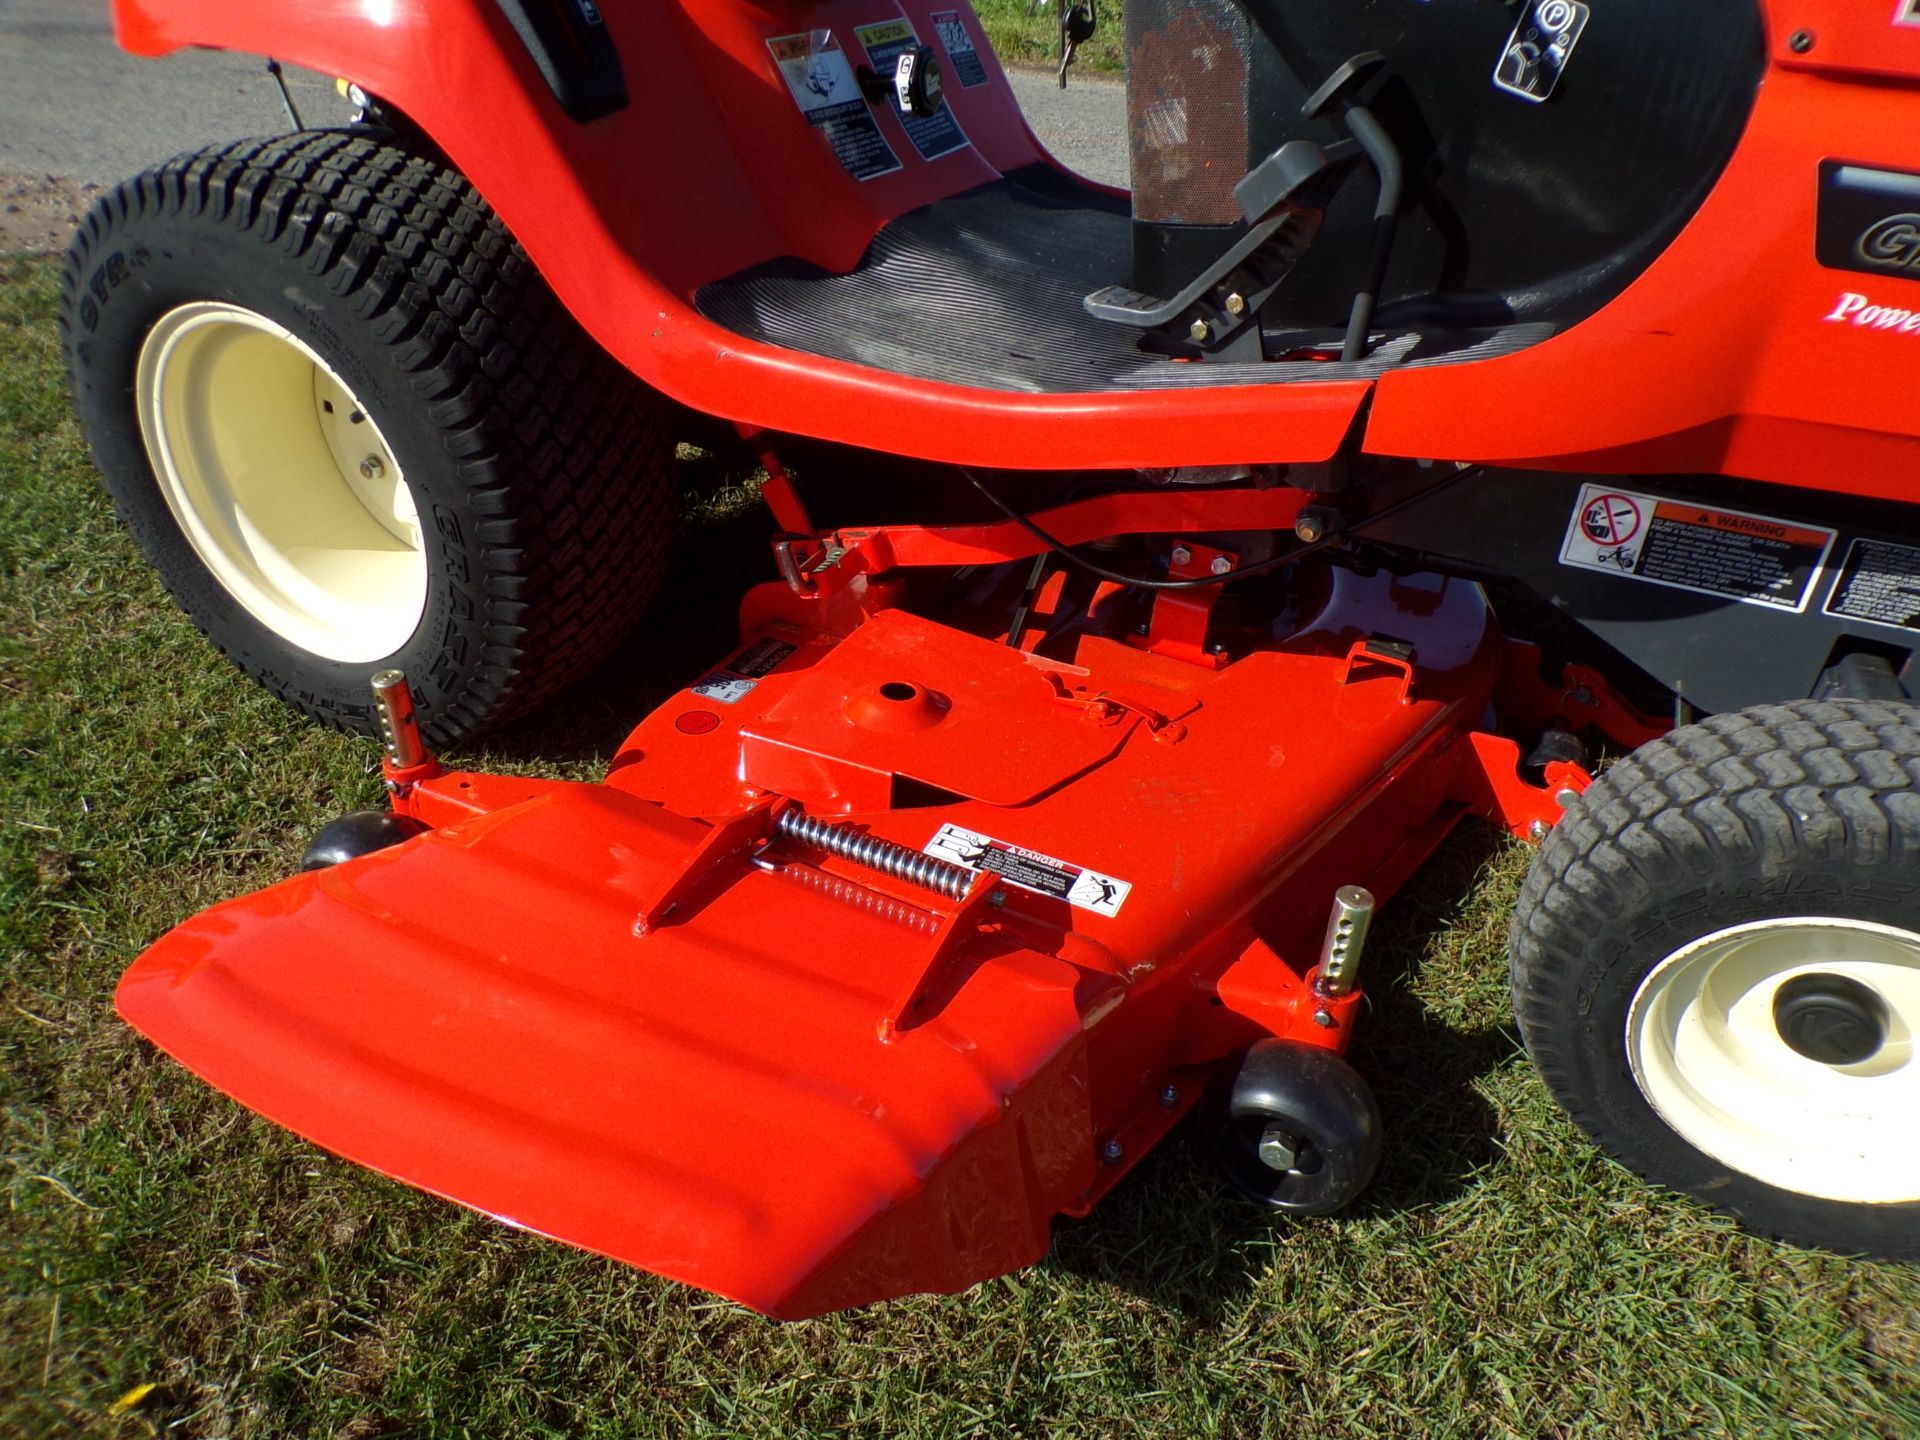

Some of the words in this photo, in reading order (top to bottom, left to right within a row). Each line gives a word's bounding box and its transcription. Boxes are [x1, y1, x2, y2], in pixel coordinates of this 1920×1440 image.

[874, 24, 906, 40] CAUTION
[80, 251, 130, 333] OTR
[1651, 524, 1672, 532] FROM
[1716, 515, 1786, 537] WARNING
[1694, 540, 1717, 550] engine
[1727, 547, 1756, 558] shorting
[1765, 540, 1791, 549] DEATH
[1719, 559, 1734, 567] may
[1762, 561, 1783, 570] safety
[983, 857, 1002, 865] MOWER
[1018, 869, 1036, 877] ENGINE
[1017, 850, 1064, 868] DANGER
[1026, 860, 1054, 871] DISCHARGE
[1000, 867, 1022, 876] OPERATE
[1022, 874, 1042, 883] MOWER
[1042, 881, 1065, 891] WITHOUT
